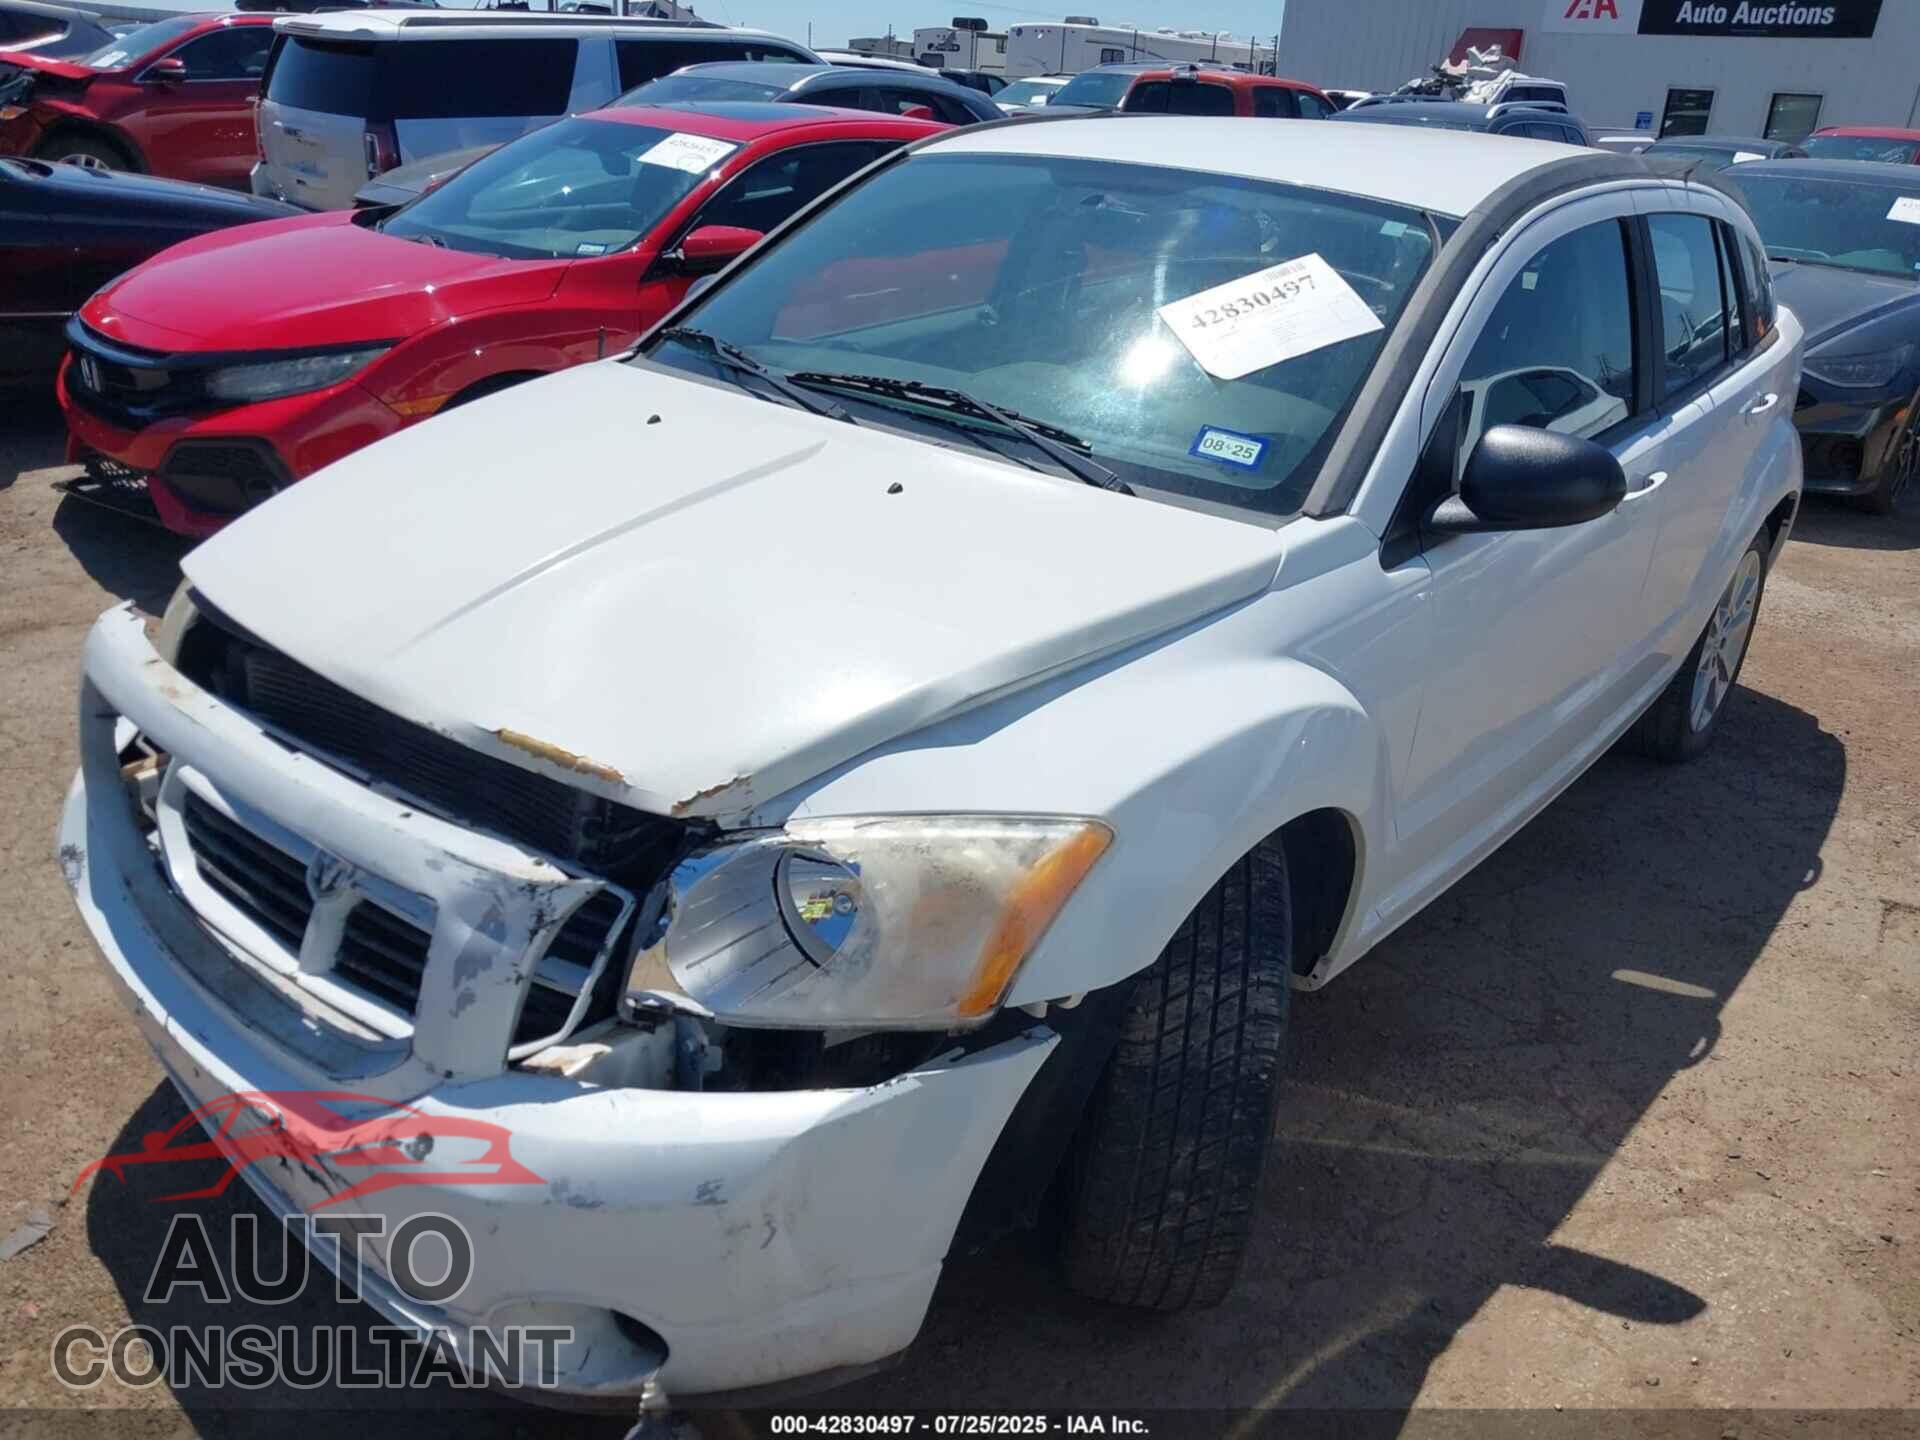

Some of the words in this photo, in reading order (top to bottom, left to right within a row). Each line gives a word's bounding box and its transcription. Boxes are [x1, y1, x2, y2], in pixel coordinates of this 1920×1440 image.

[1675, 1, 1726, 25] Auto
[1731, 2, 1836, 25] Auctions
[1191, 274, 1317, 330] 42830497
[1202, 438, 1225, 452] 08
[1232, 444, 1255, 460] 25
